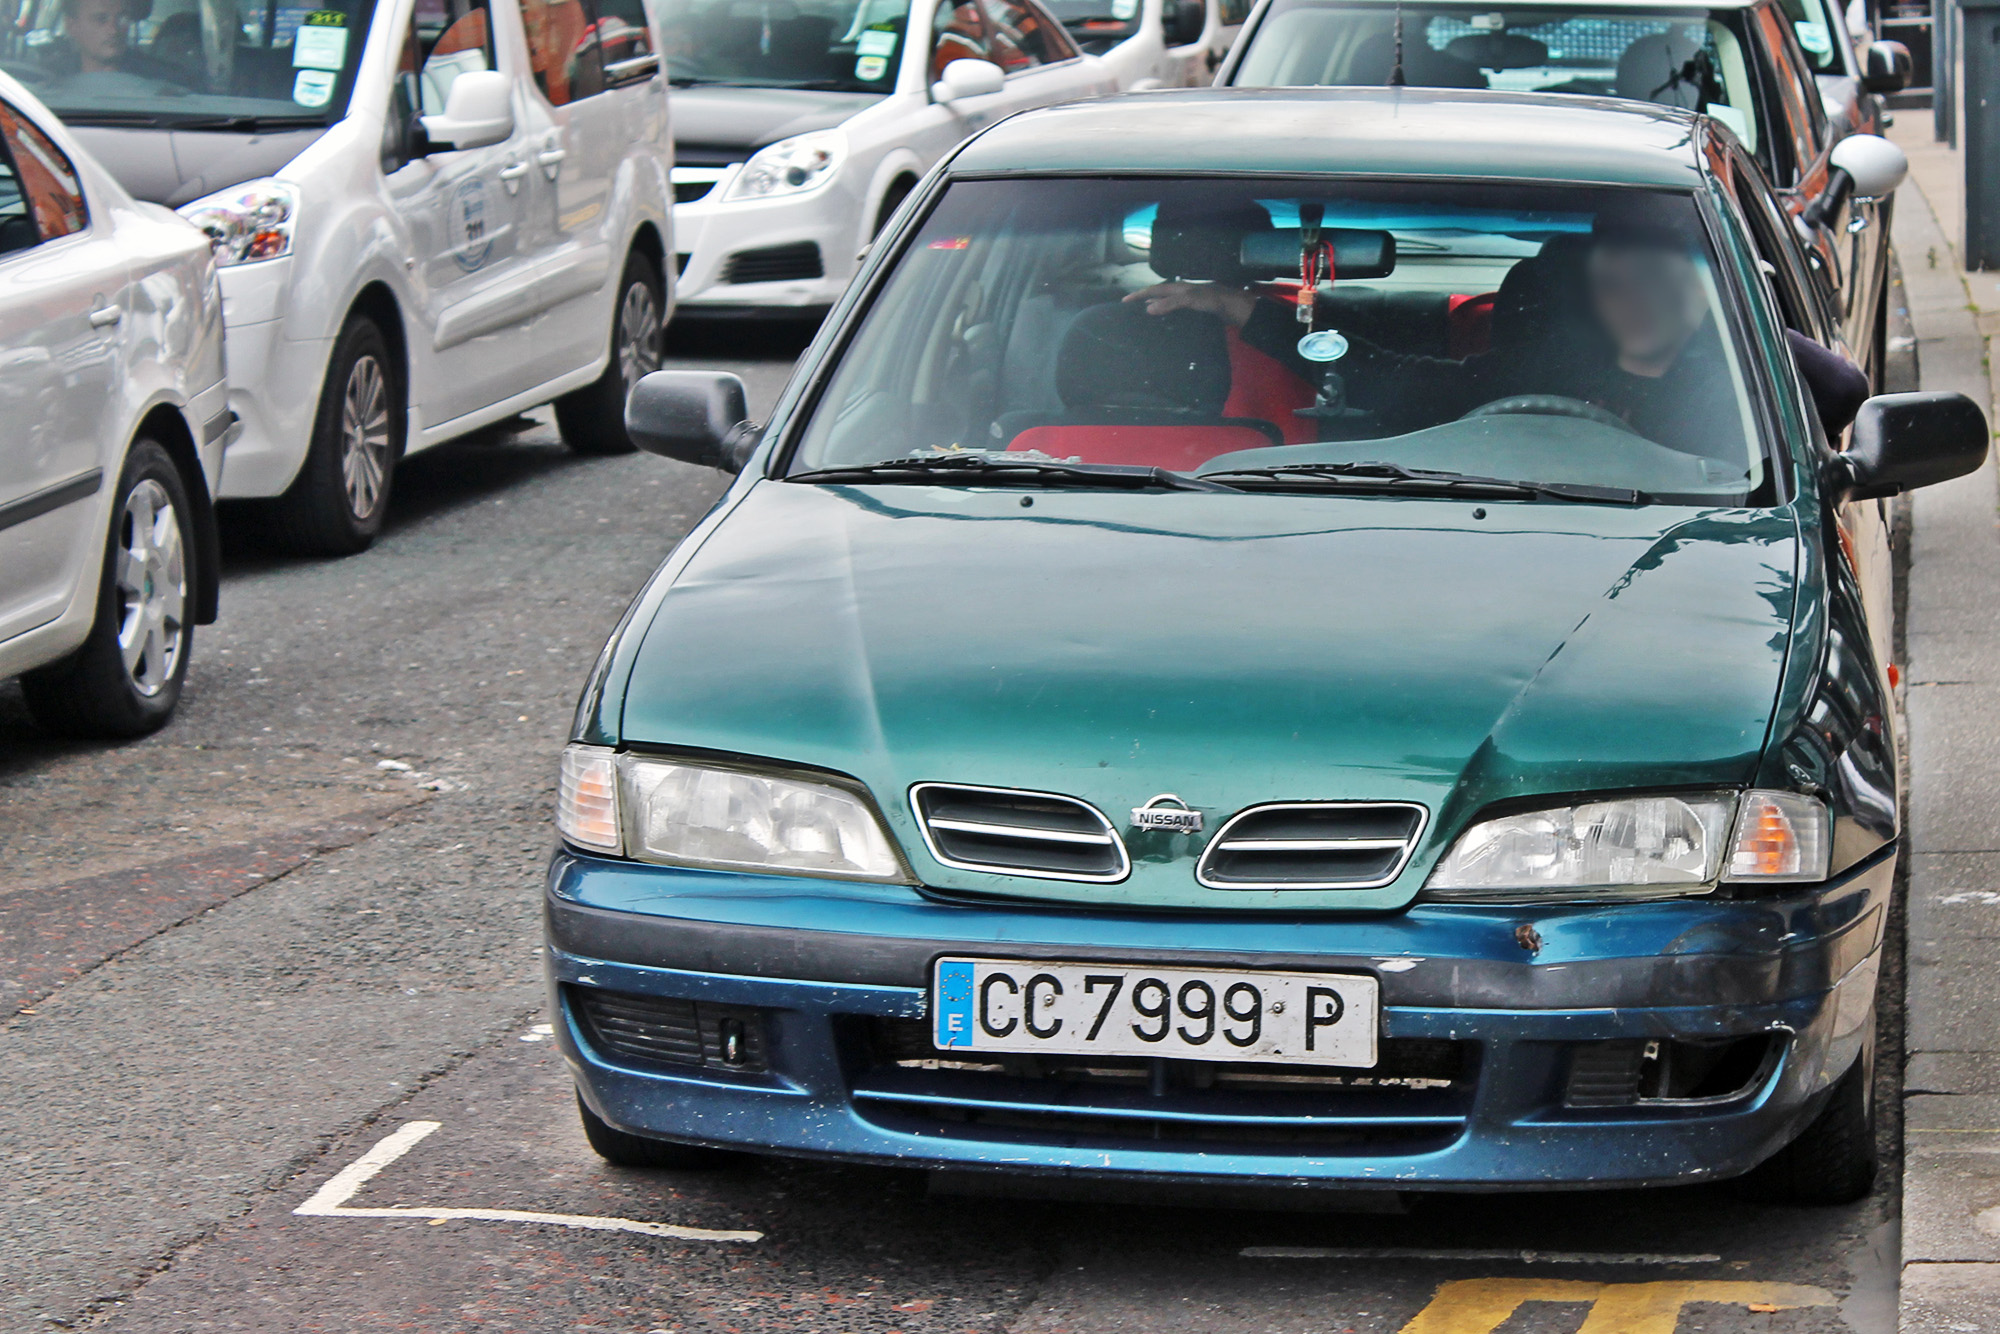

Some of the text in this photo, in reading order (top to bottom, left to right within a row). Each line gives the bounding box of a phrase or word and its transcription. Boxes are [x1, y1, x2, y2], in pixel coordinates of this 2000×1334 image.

[1139, 813, 1194, 827] NISSAN
[979, 972, 1344, 1051] CC 7999 P
[947, 1012, 964, 1032] E
